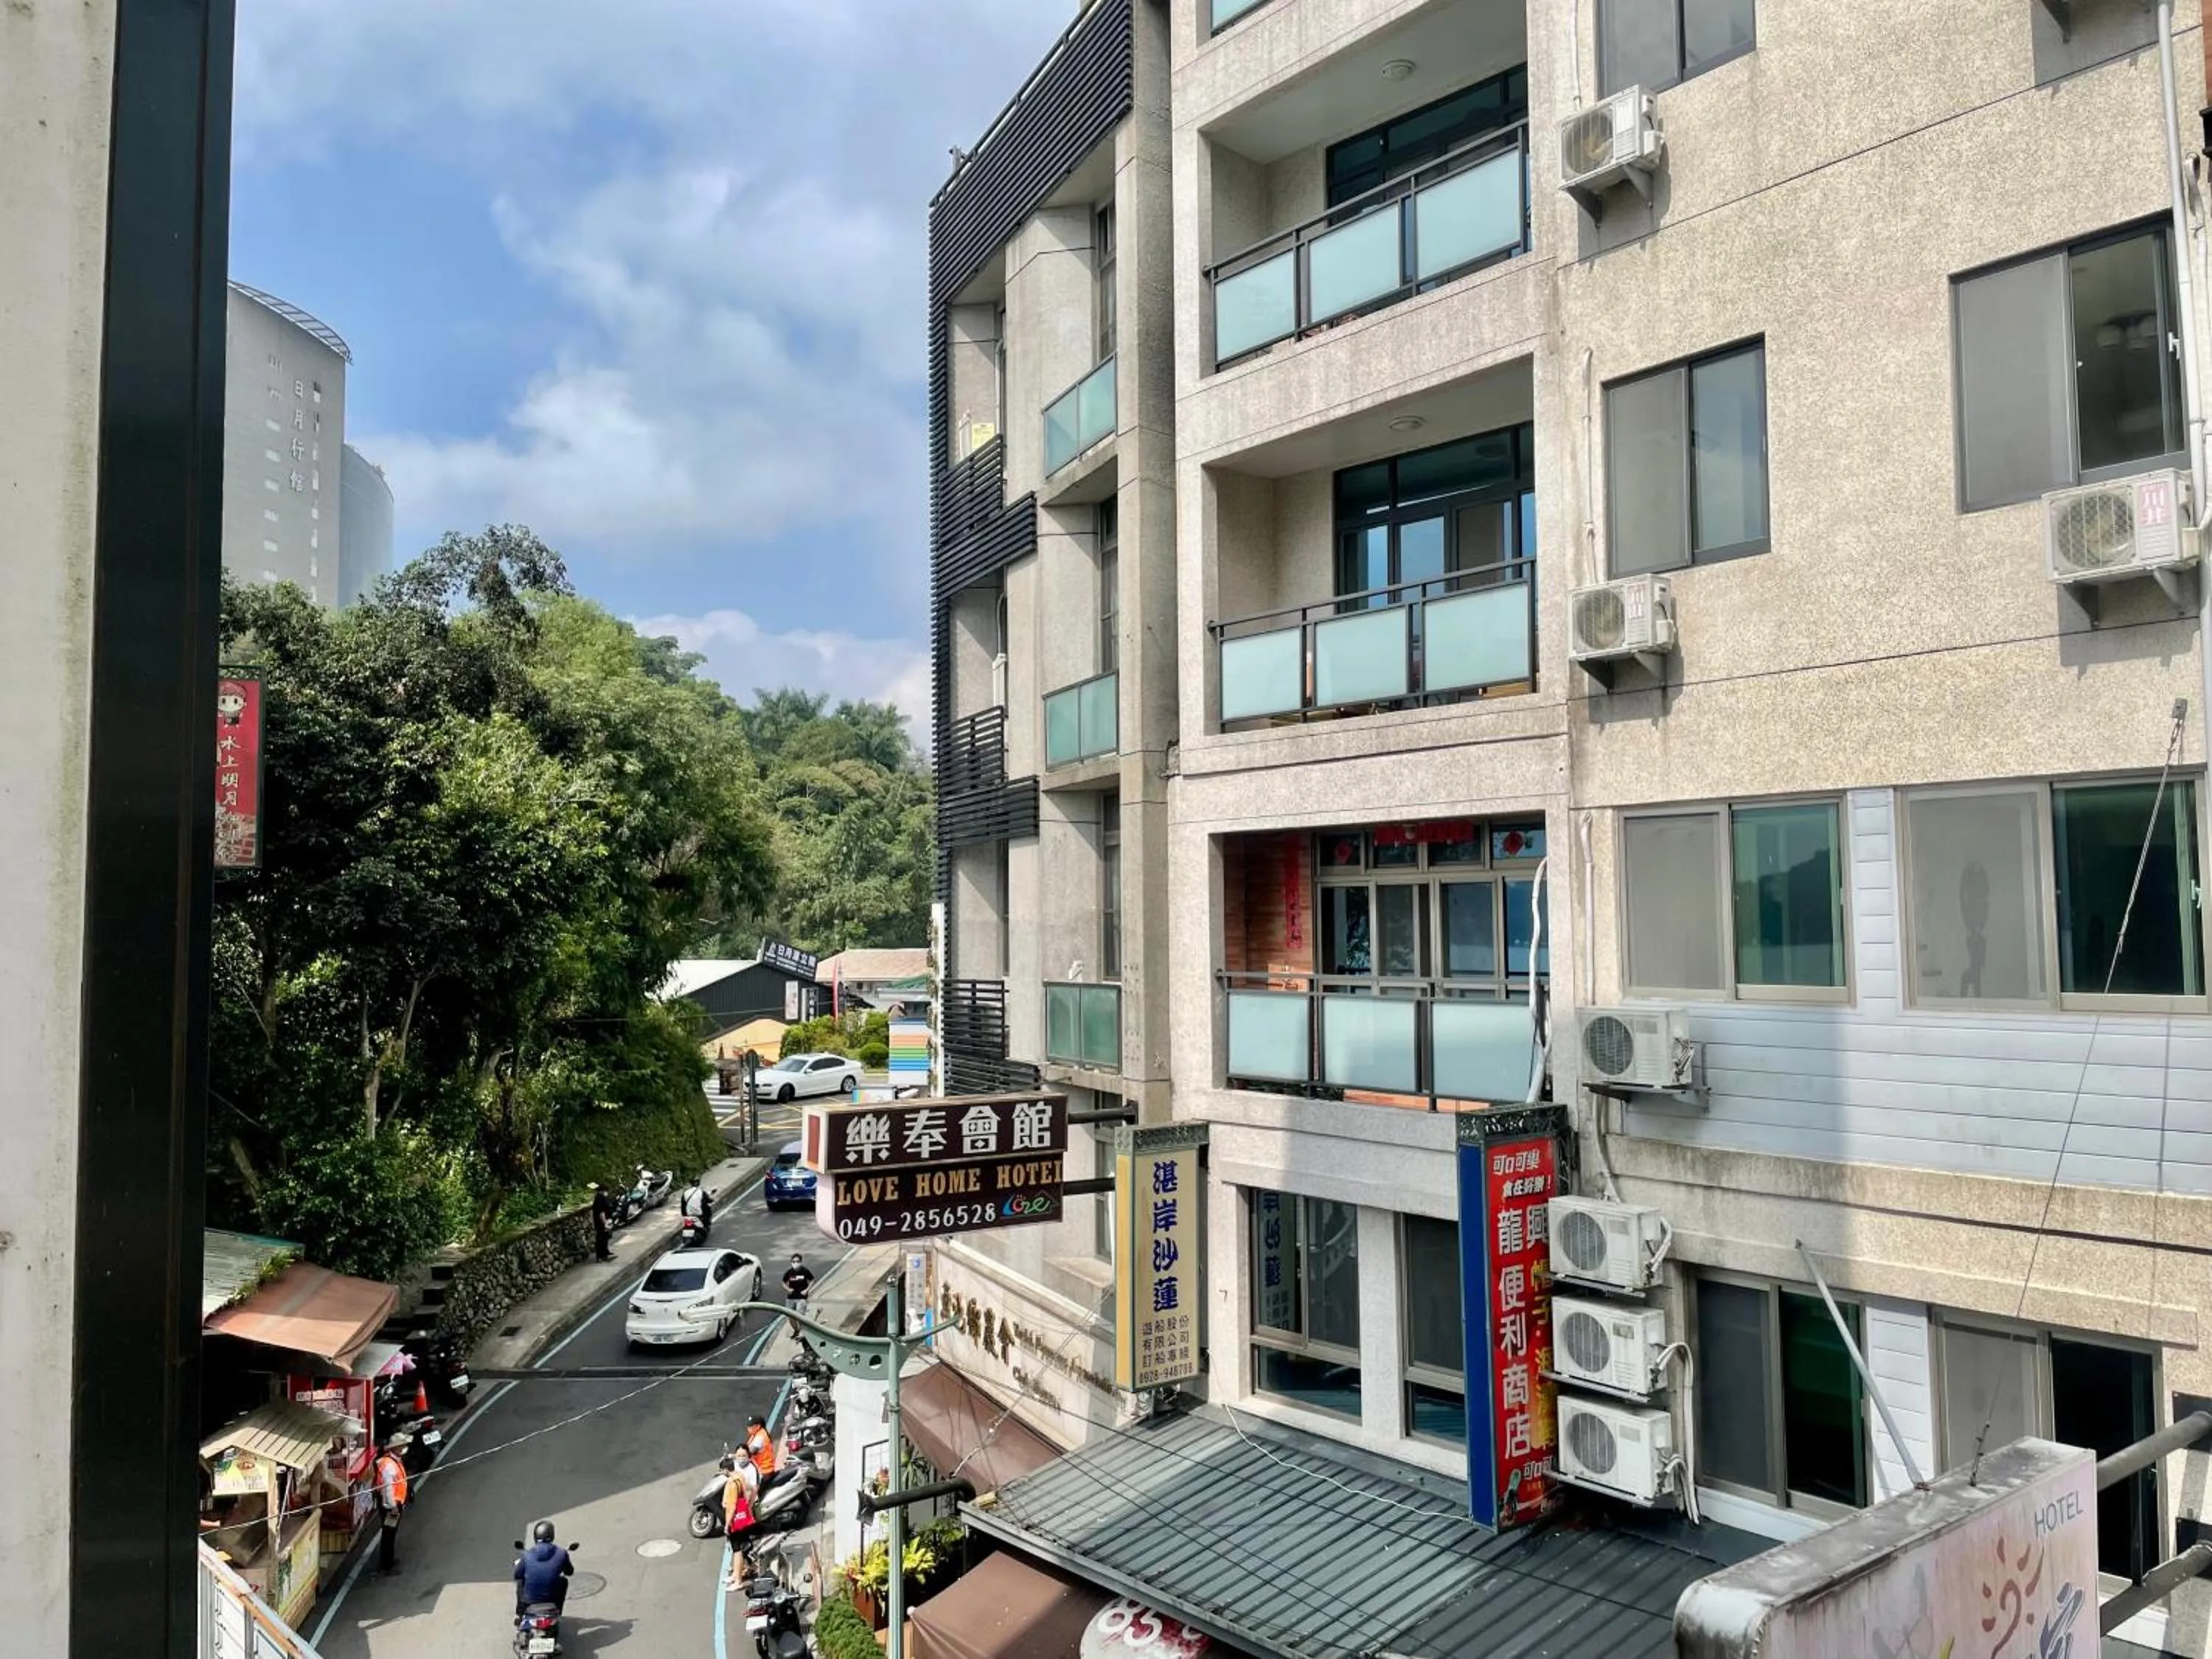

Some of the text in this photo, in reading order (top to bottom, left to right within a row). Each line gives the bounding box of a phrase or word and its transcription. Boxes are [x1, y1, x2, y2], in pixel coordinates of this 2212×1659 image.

[1493, 1148, 1540, 1176] 可口可樂
[837, 1176, 899, 1206] LOVE
[915, 1167, 981, 1197] HOME
[838, 1203, 997, 1240] 049-2856528
[1142, 1330, 1189, 1352] 有限公司
[2035, 1490, 2084, 1538] HOTEL
